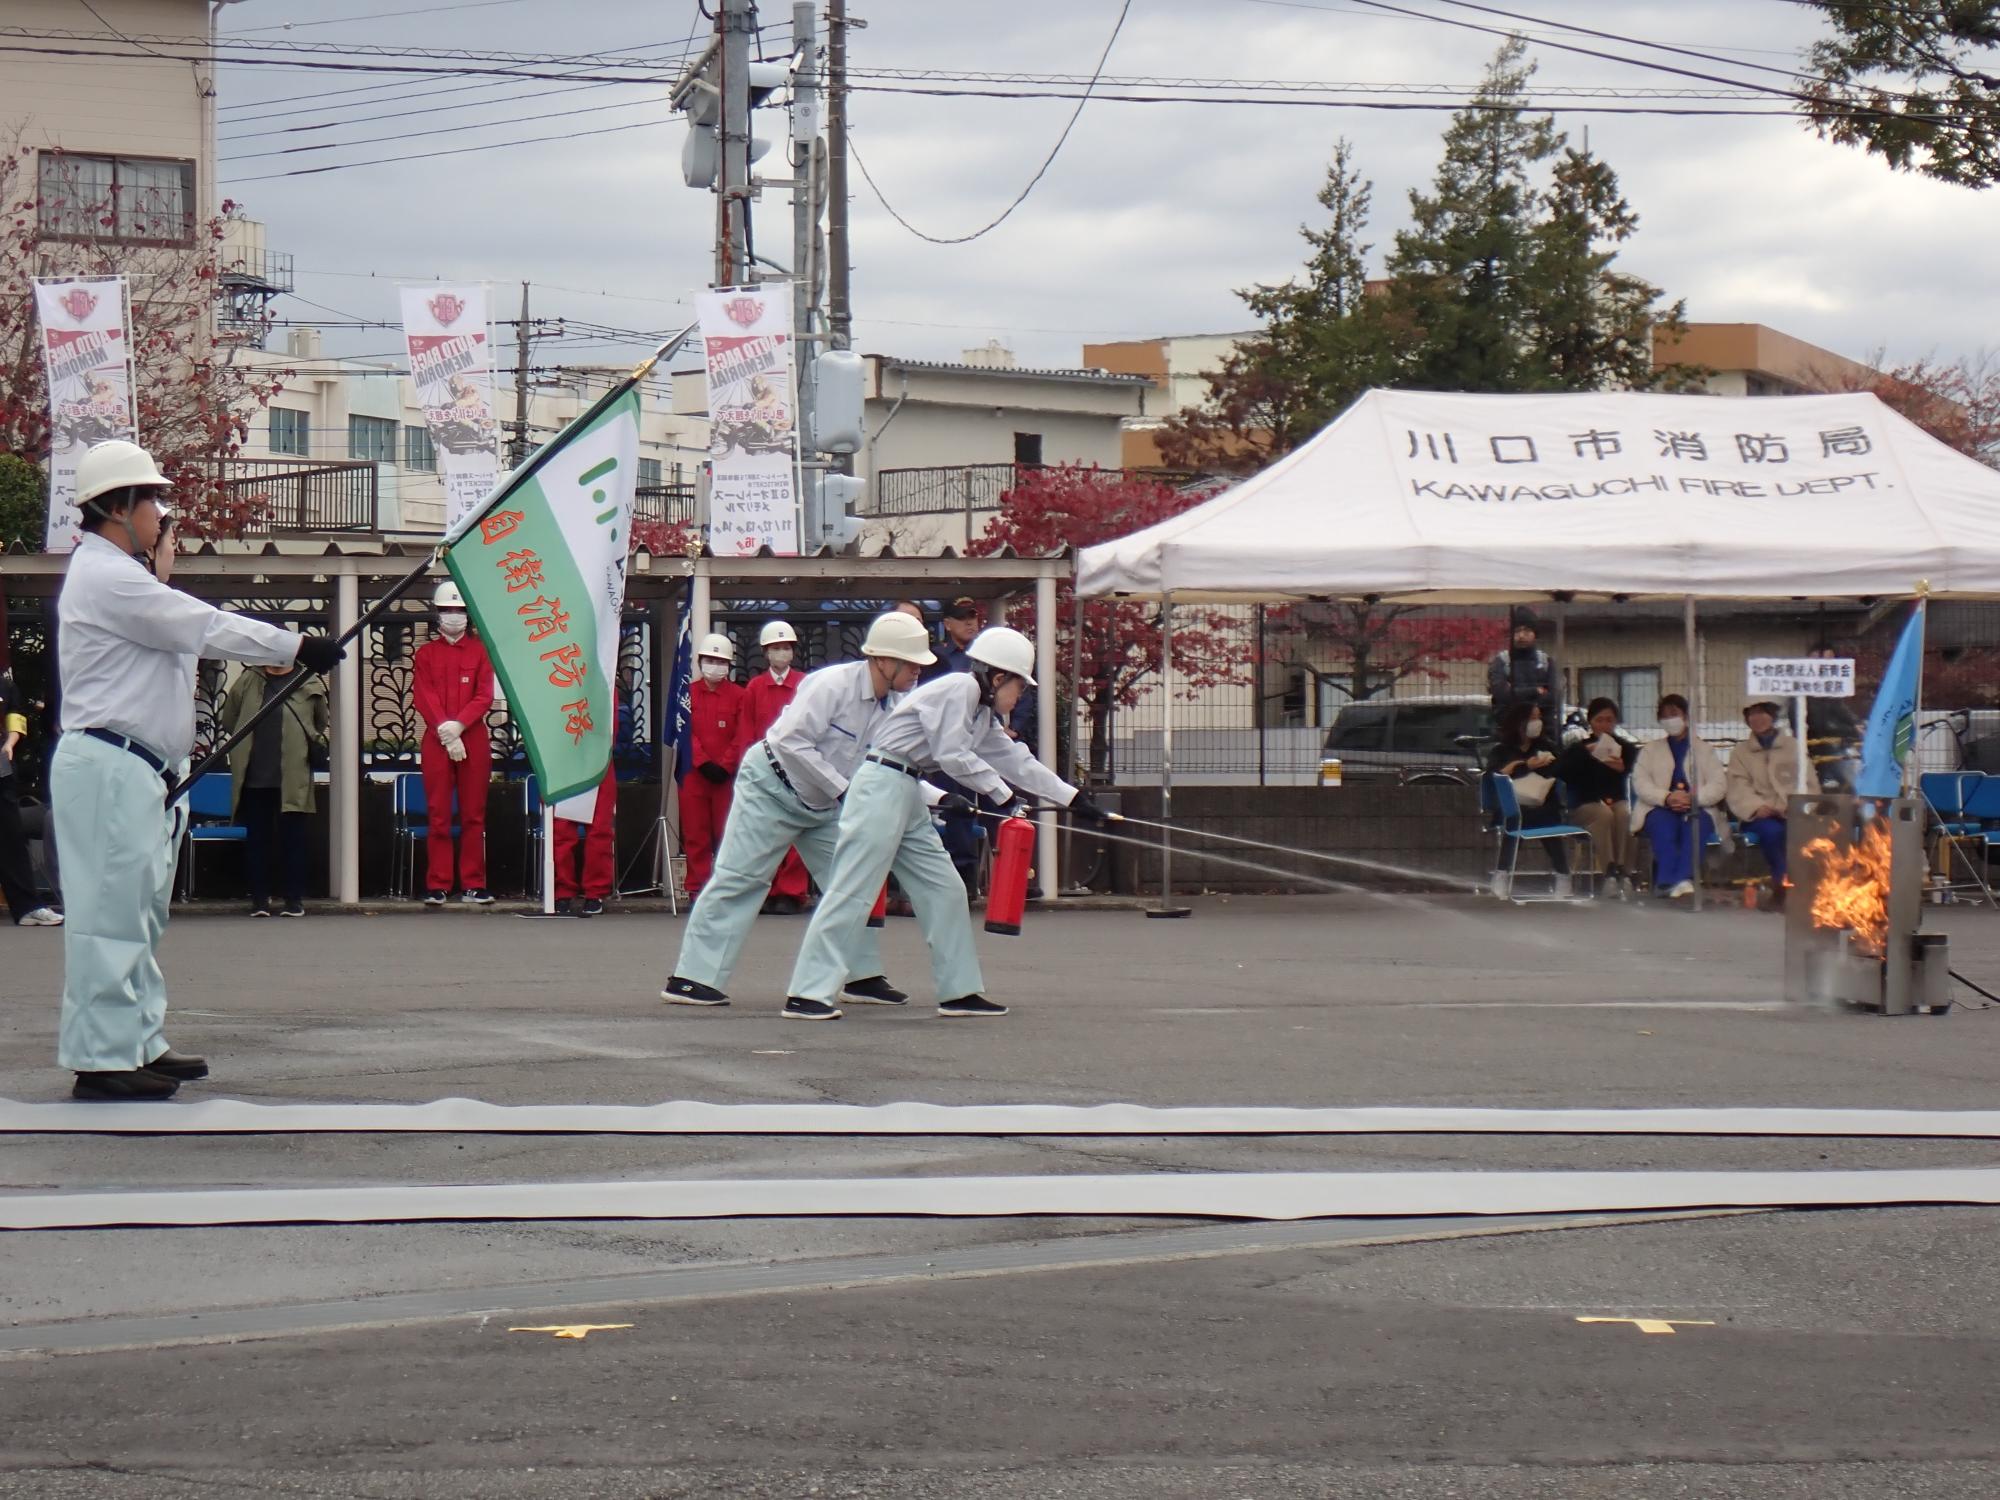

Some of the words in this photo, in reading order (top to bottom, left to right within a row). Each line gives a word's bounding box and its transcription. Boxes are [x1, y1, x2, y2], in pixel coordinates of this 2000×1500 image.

[1407, 425, 1874, 465] 川口市消防局
[1411, 474, 1670, 503] KAWAGUCHI
[1677, 477, 1768, 499] FIRE
[1775, 471, 1896, 498] DEPT.
[480, 509, 596, 746] 自衛消防隊
